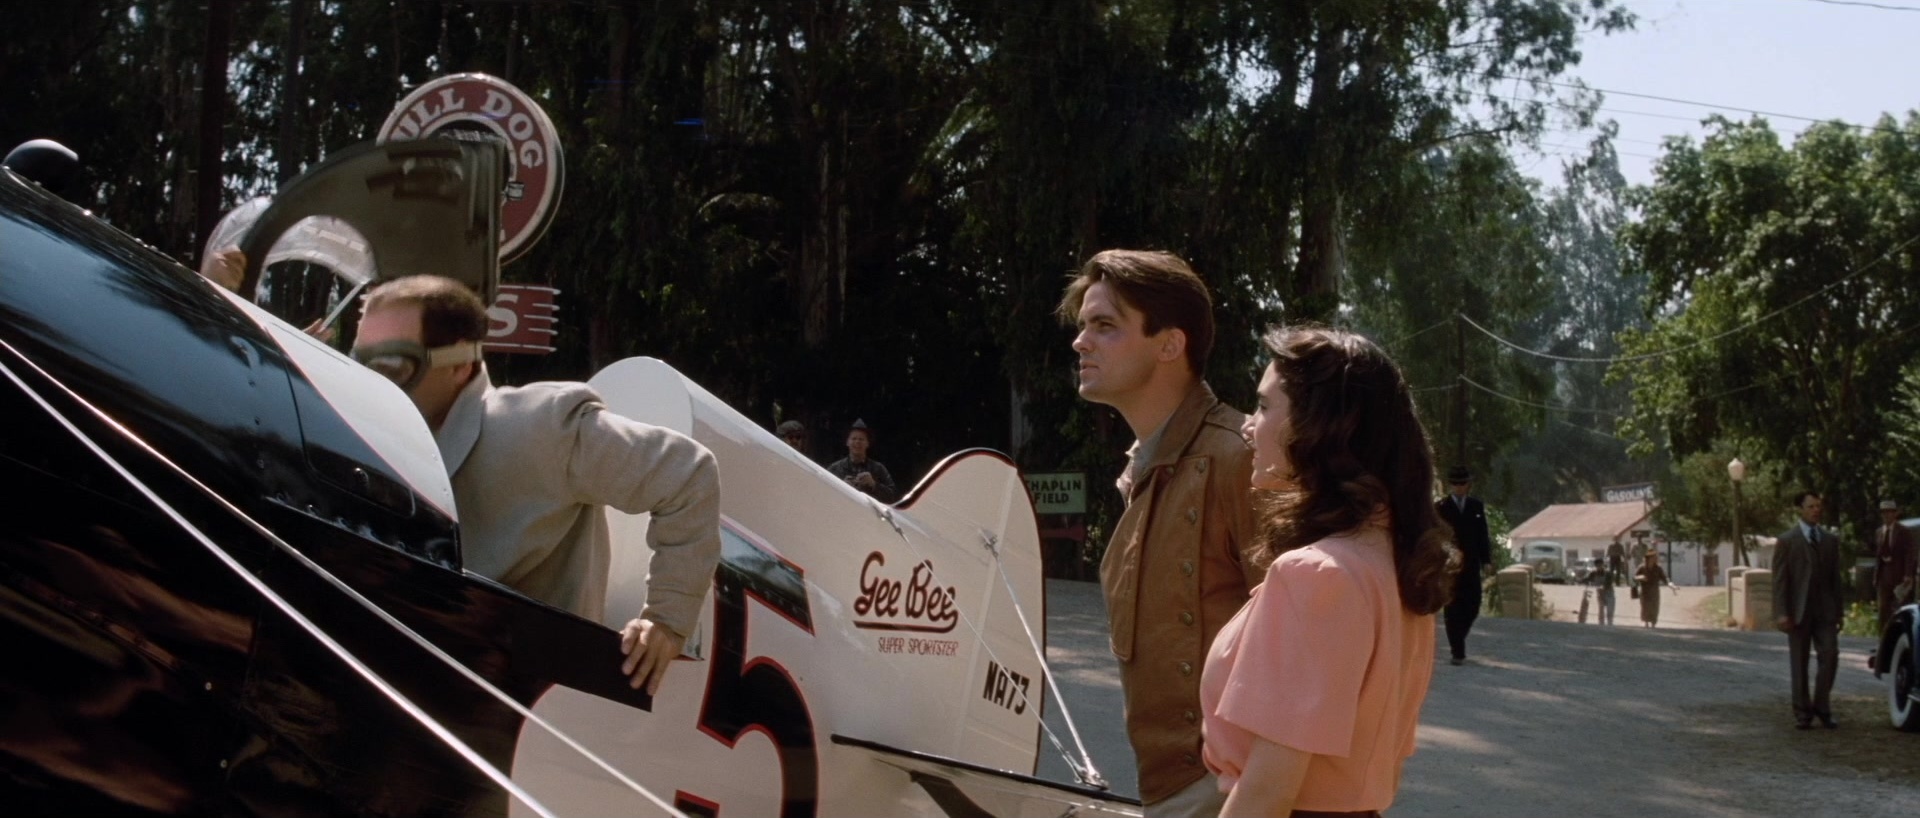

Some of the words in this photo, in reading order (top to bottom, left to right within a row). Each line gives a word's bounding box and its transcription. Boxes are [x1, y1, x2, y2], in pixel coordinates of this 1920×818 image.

[390, 88, 465, 141] ULL
[480, 89, 544, 169] DOG
[1025, 480, 1081, 491] HAPLIN
[1607, 486, 1655, 502] GASOLINE
[1034, 493, 1069, 504] FIELD
[853, 551, 902, 617] Gee
[905, 559, 959, 630] Bee
[878, 637, 904, 654] SUPER
[908, 638, 959, 656] SPORTSTER
[671, 514, 819, 818] 5
